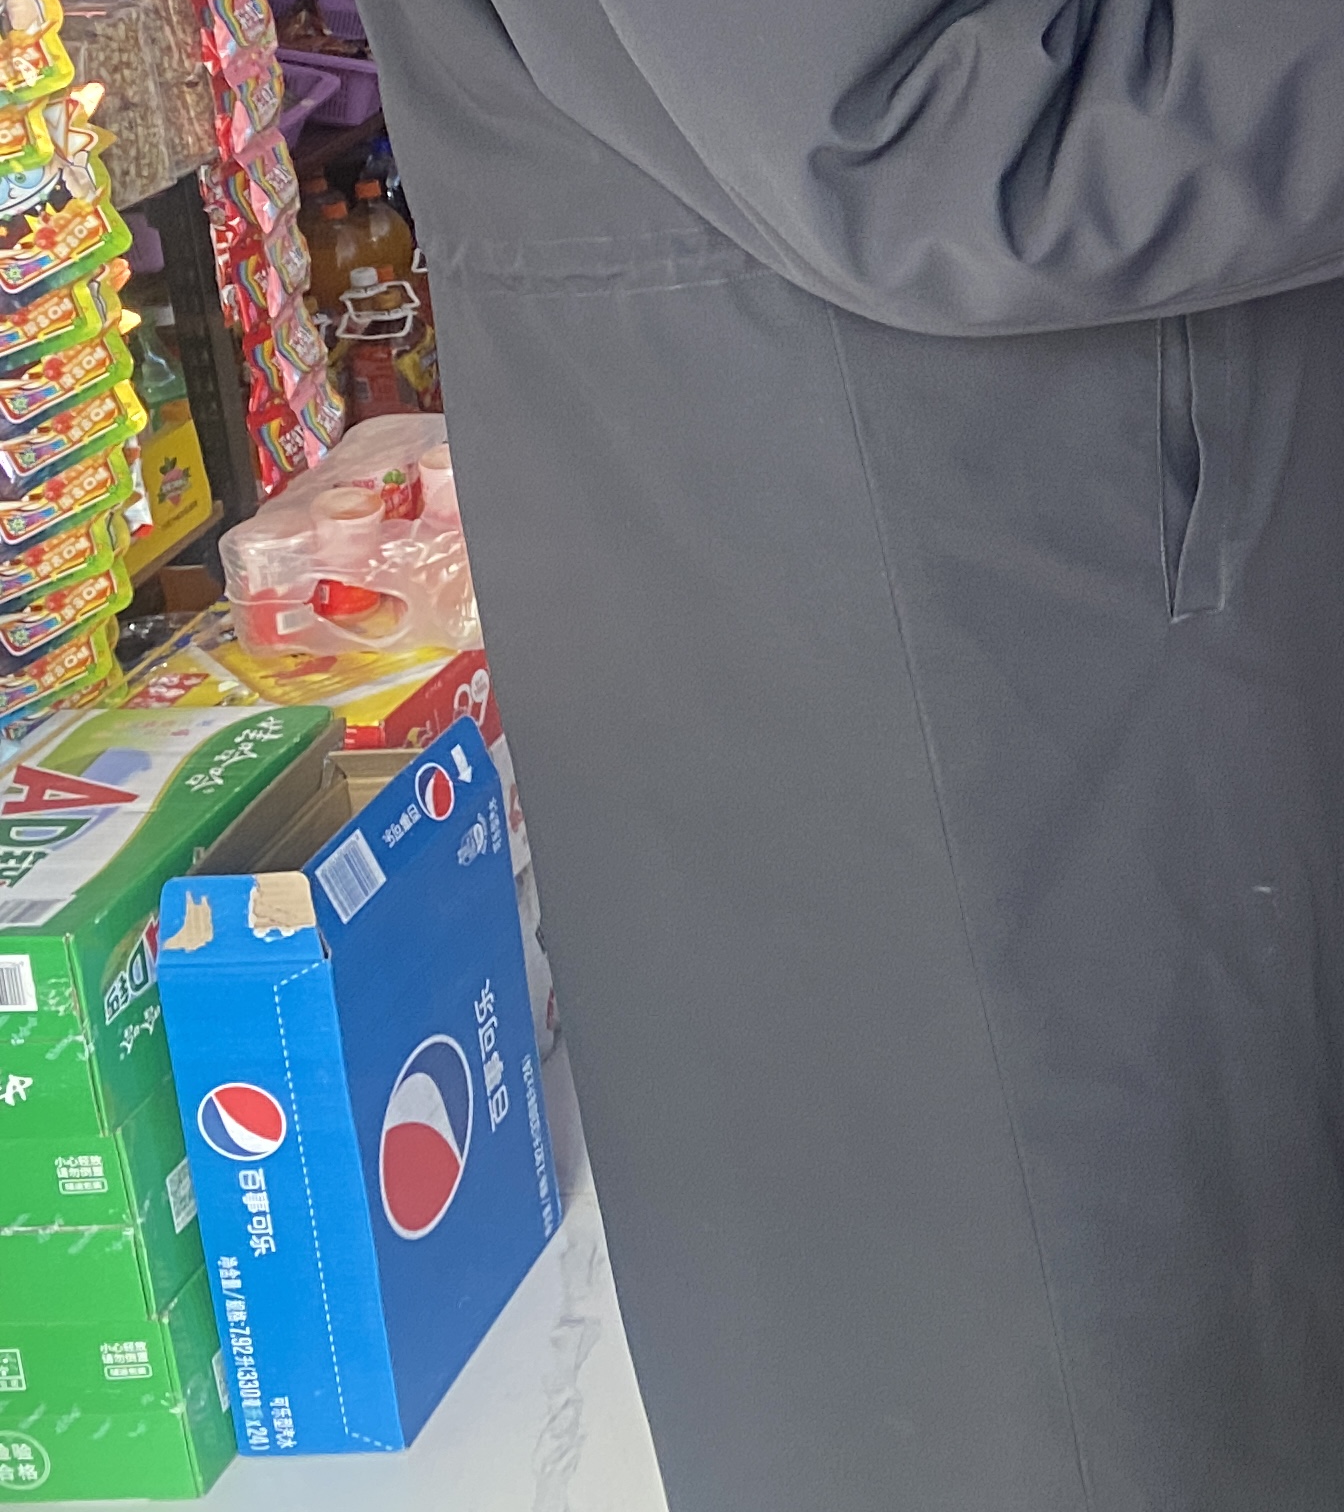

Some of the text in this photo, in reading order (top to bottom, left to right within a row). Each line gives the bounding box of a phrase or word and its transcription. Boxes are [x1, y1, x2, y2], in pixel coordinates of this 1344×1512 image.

[473, 978, 509, 1132] 百事可乐
[238, 1168, 276, 1258] 百事可乐
